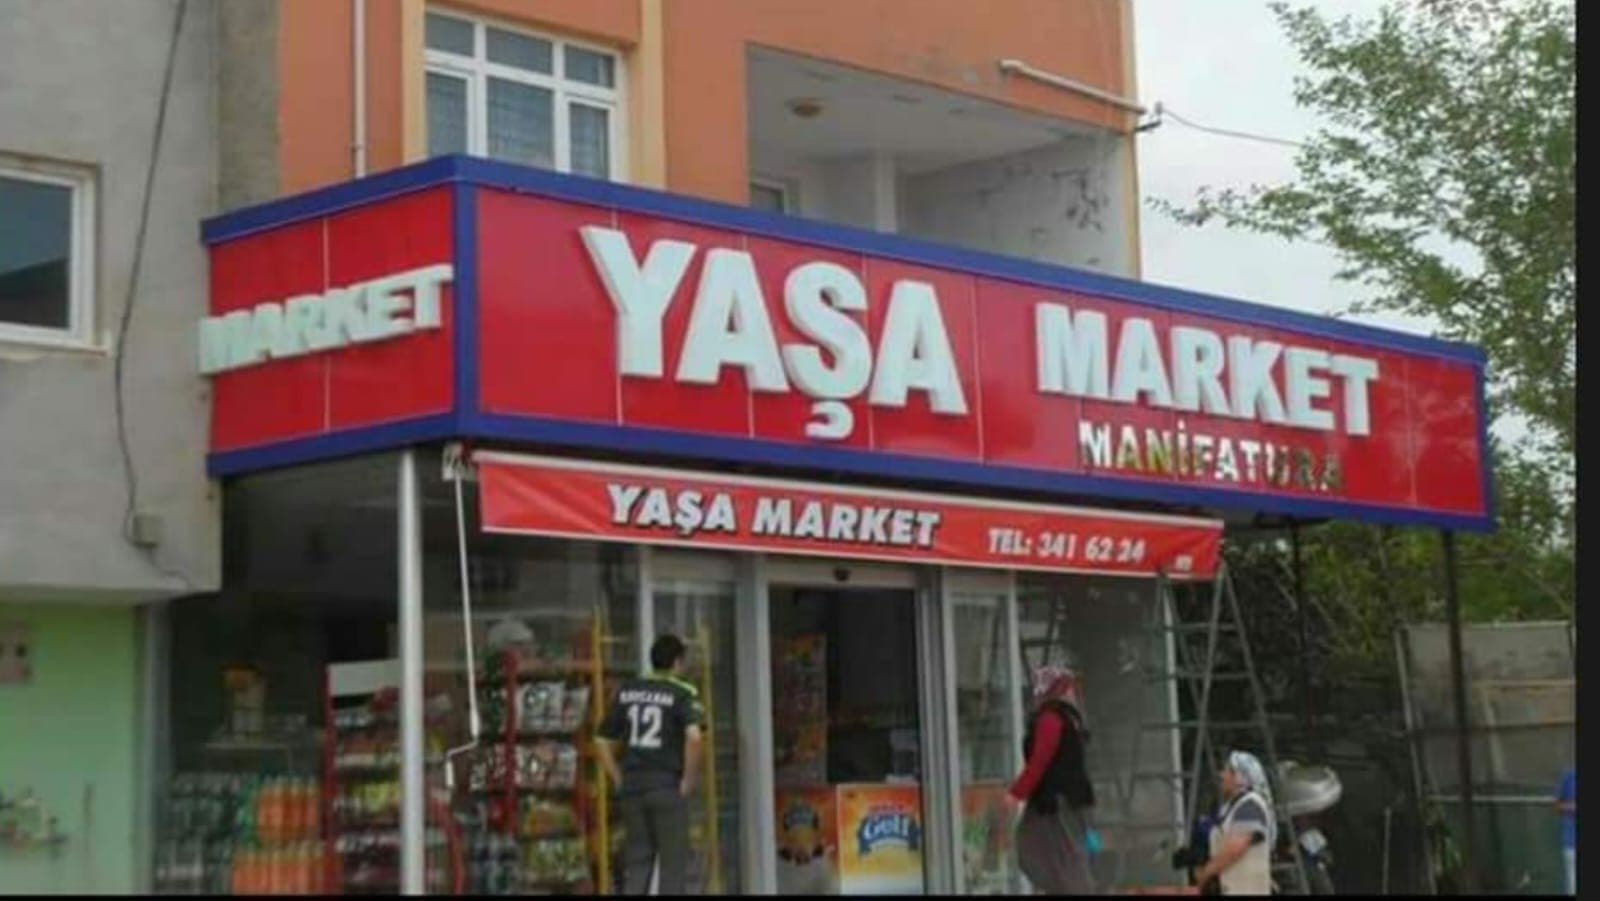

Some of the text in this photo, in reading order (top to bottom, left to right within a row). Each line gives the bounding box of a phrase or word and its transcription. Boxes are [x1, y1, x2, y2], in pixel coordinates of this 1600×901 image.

[199, 263, 453, 376] MARKET
[580, 225, 1379, 439] YAŞA MARKET
[1079, 420, 1343, 492] MANİFATURA
[607, 483, 940, 547] YAŞA MARKET
[987, 528, 1032, 555] TEL:
[1037, 532, 1077, 560] 341
[627, 703, 662, 748] 12
